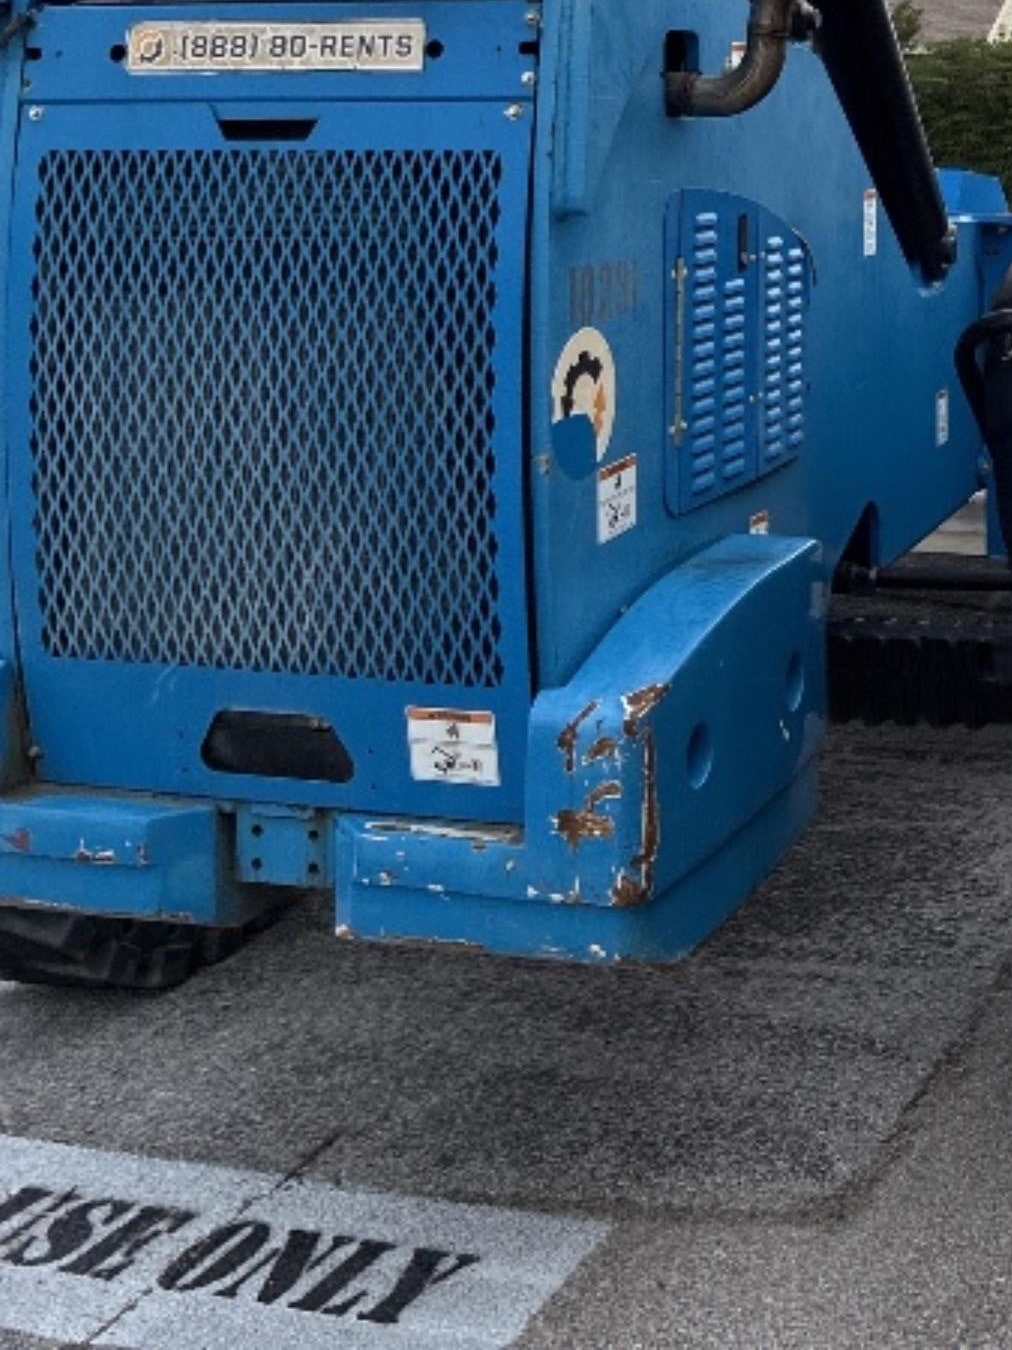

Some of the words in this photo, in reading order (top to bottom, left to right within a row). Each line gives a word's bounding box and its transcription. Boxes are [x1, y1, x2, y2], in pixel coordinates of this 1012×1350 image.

[180, 33, 258, 61] (888)
[268, 34, 413, 59] 80-RENTS
[157, 1220, 481, 1324] ONLY
